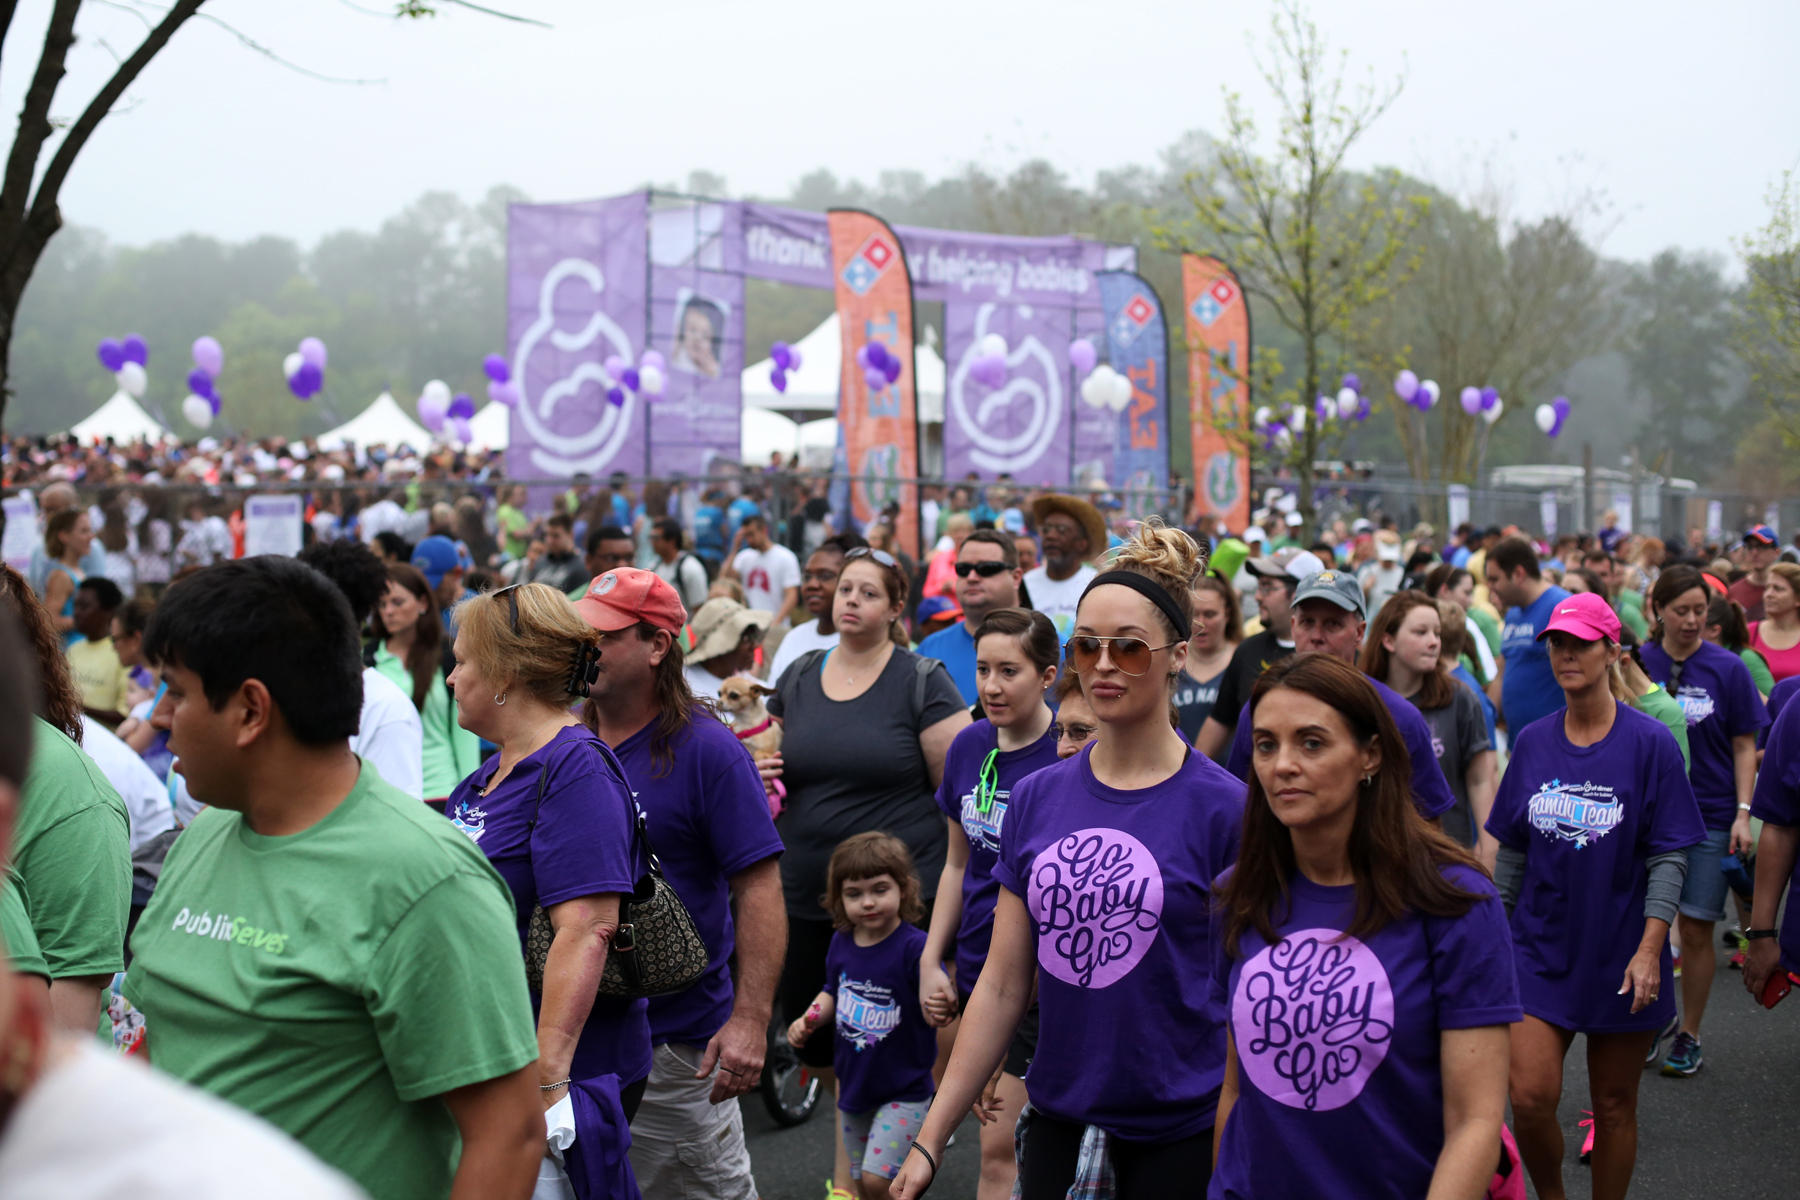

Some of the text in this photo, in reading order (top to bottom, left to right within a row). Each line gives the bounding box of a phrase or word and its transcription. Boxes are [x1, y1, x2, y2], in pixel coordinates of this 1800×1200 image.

[745, 225, 827, 268] thank
[928, 246, 1014, 297] helping
[1017, 256, 1089, 293] babies
[1528, 792, 1624, 827] Family Team
[1537, 817, 1557, 830] 2015
[1058, 834, 1132, 891] Go
[1036, 863, 1160, 935] Baby
[1055, 927, 1133, 987] Go
[1269, 938, 1352, 1000] Go
[859, 1002, 901, 1030] Team
[1247, 966, 1392, 1055] Baby
[1274, 1042, 1362, 1111] Go
